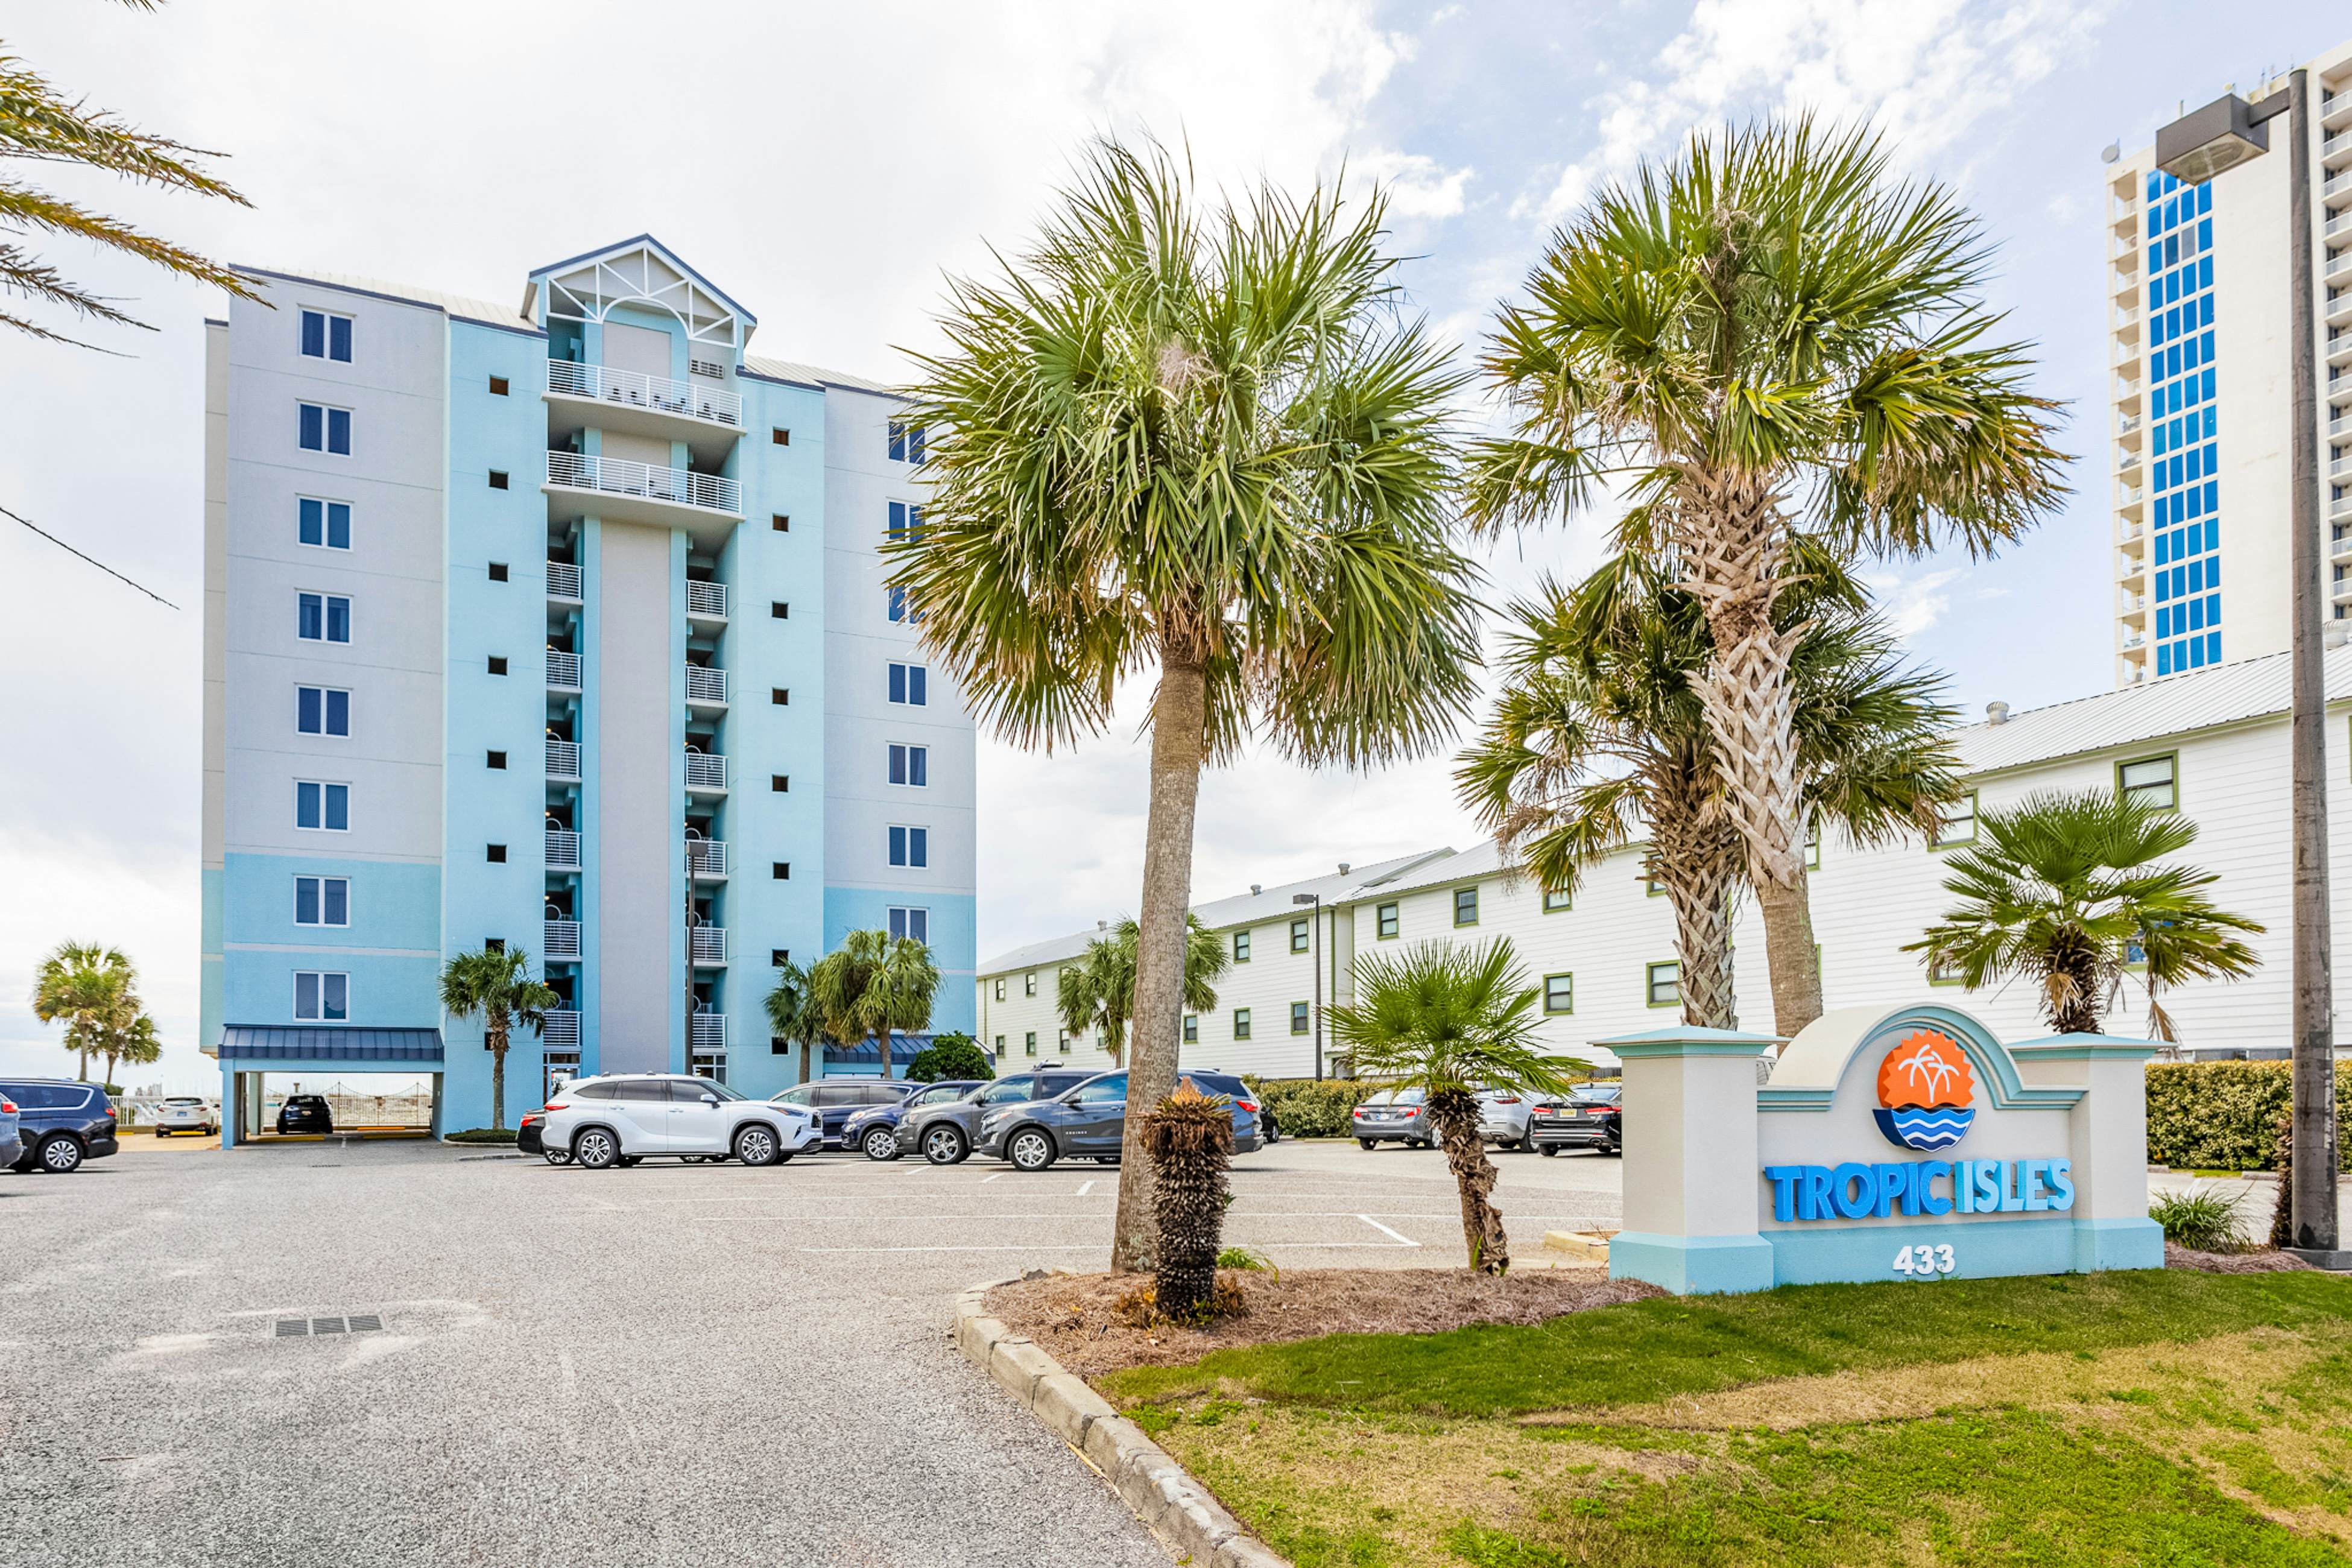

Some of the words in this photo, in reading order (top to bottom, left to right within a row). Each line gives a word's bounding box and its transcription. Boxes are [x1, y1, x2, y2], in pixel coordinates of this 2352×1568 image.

[1765, 1160, 1953, 1222] TROPIC
[1954, 1158, 2075, 1213] ISLES
[1892, 1244, 1956, 1276] 433
